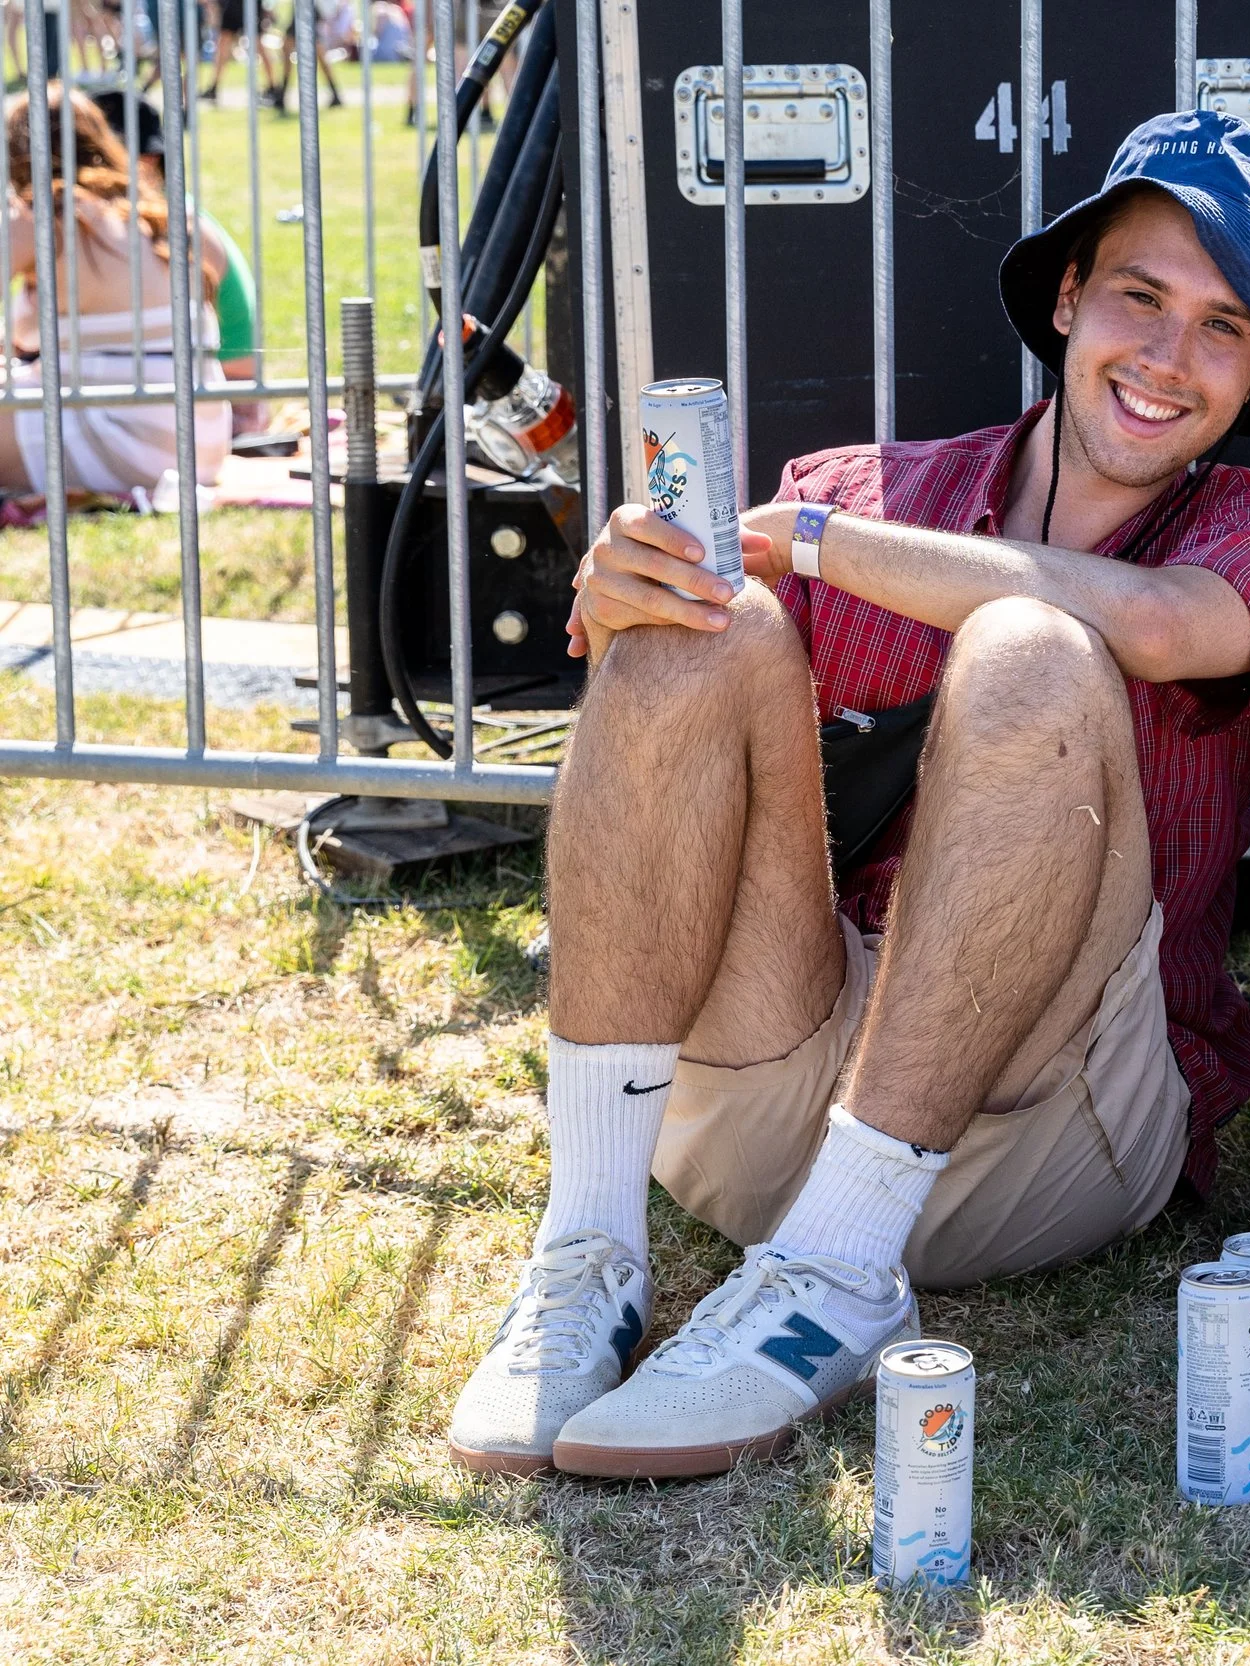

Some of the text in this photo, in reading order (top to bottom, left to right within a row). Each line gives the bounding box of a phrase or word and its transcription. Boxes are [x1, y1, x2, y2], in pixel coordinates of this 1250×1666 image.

[975, 80, 1072, 155] 44
[755, 1311, 845, 1382] N
[919, 1403, 953, 1427] GOOD
[920, 1447, 937, 1458] HARD
[935, 1506, 947, 1514] No
[934, 1530, 946, 1538] No
[934, 1559, 945, 1567] 85
